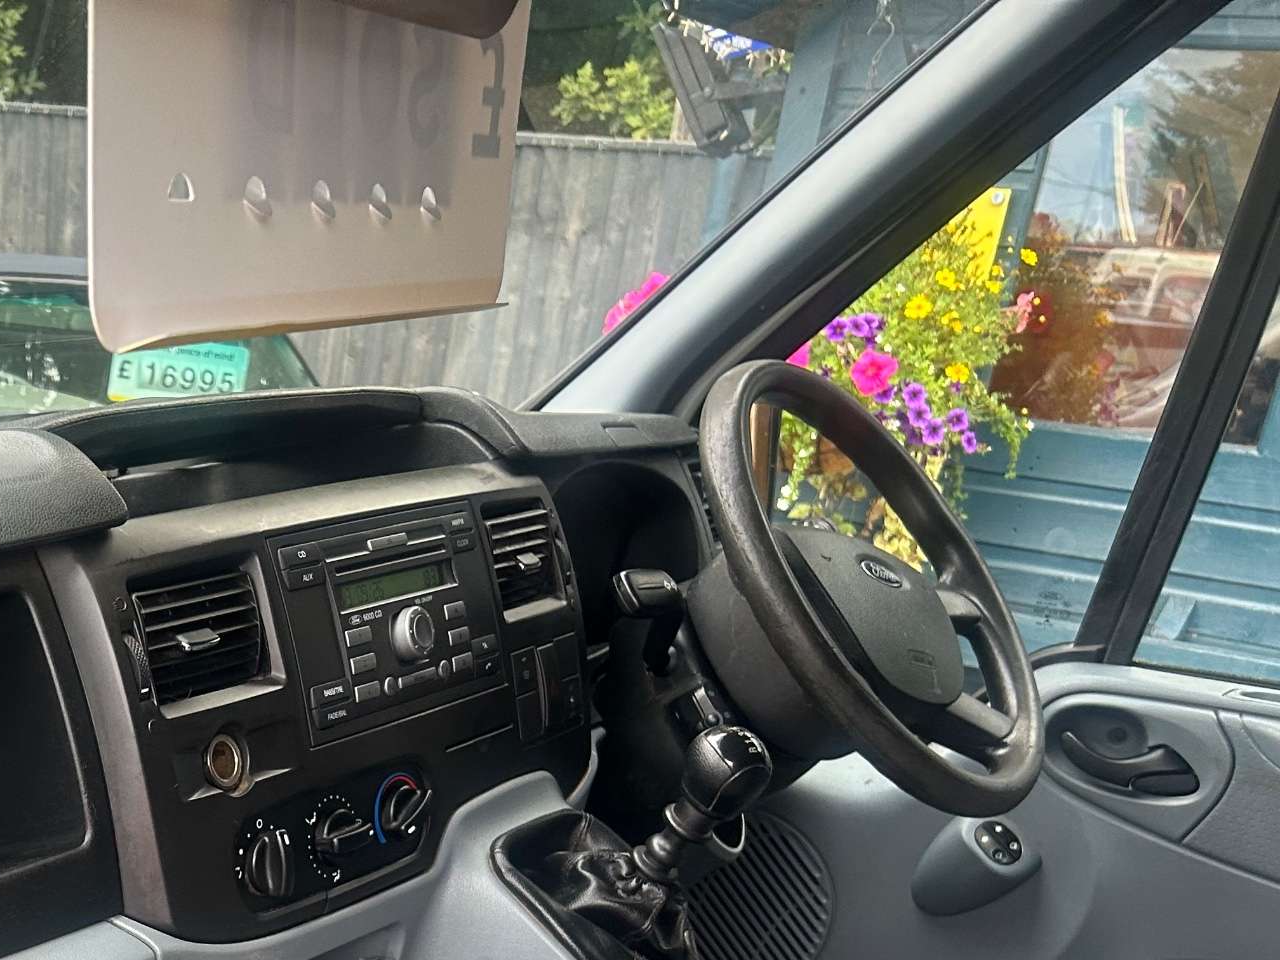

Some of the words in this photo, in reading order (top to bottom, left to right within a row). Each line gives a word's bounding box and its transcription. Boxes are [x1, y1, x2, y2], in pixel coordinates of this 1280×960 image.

[117, 360, 132, 380] £
[145, 362, 234, 393] 16995
[297, 550, 307, 559] CD
[302, 573, 314, 582] AUX
